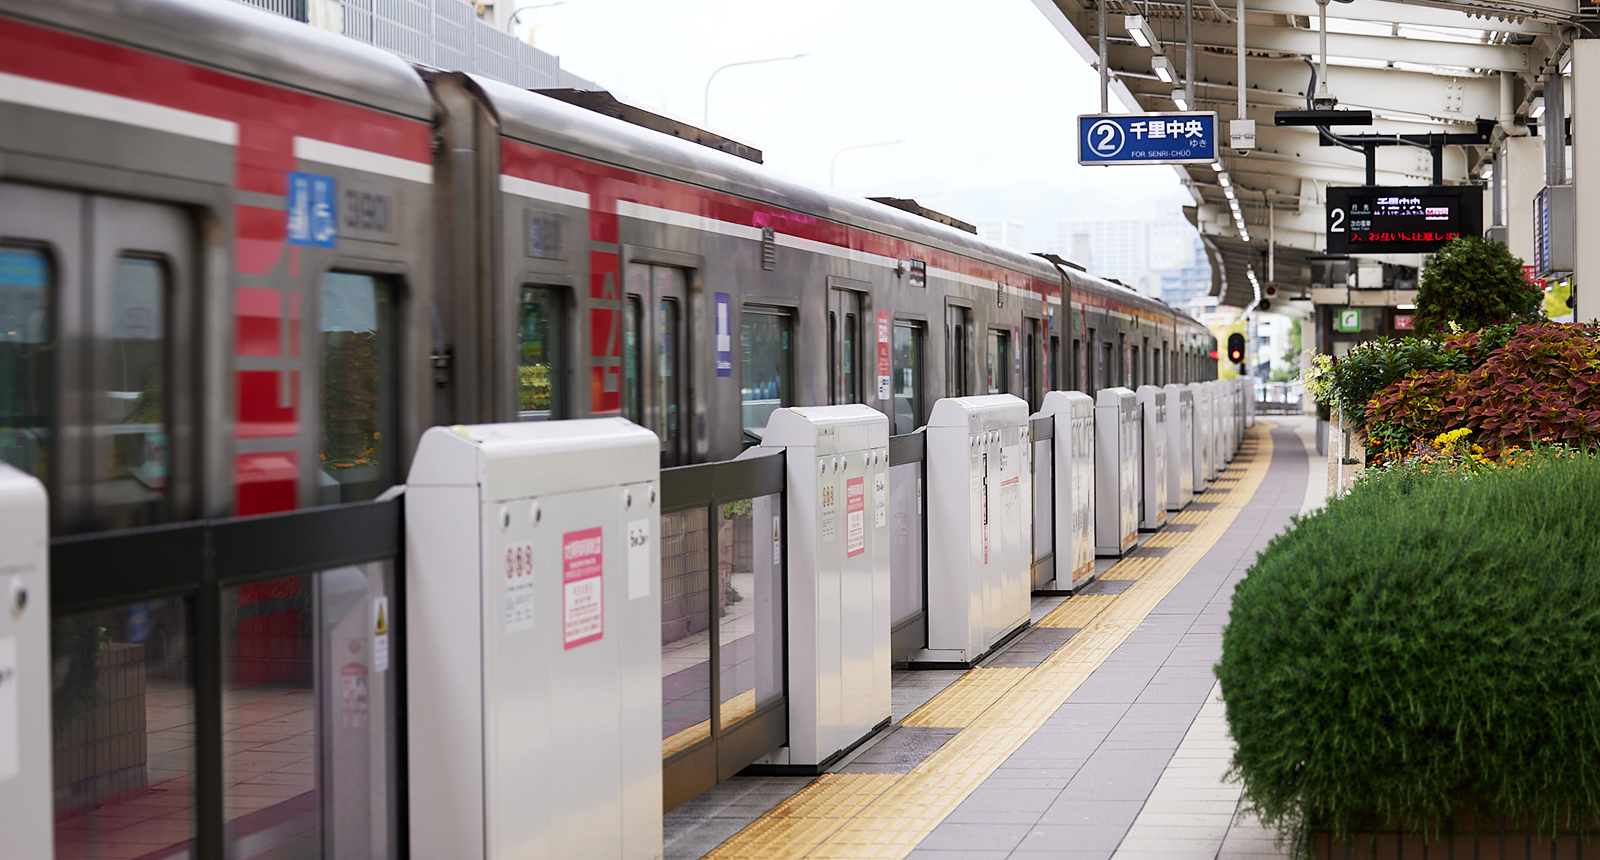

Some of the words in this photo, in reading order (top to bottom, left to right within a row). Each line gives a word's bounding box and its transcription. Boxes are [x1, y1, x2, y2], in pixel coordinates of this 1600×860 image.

[1097, 125, 1115, 150] 2
[1130, 120, 1203, 140] 千里中央
[1189, 139, 1207, 148] ゆき
[1331, 208, 1345, 232] 2
